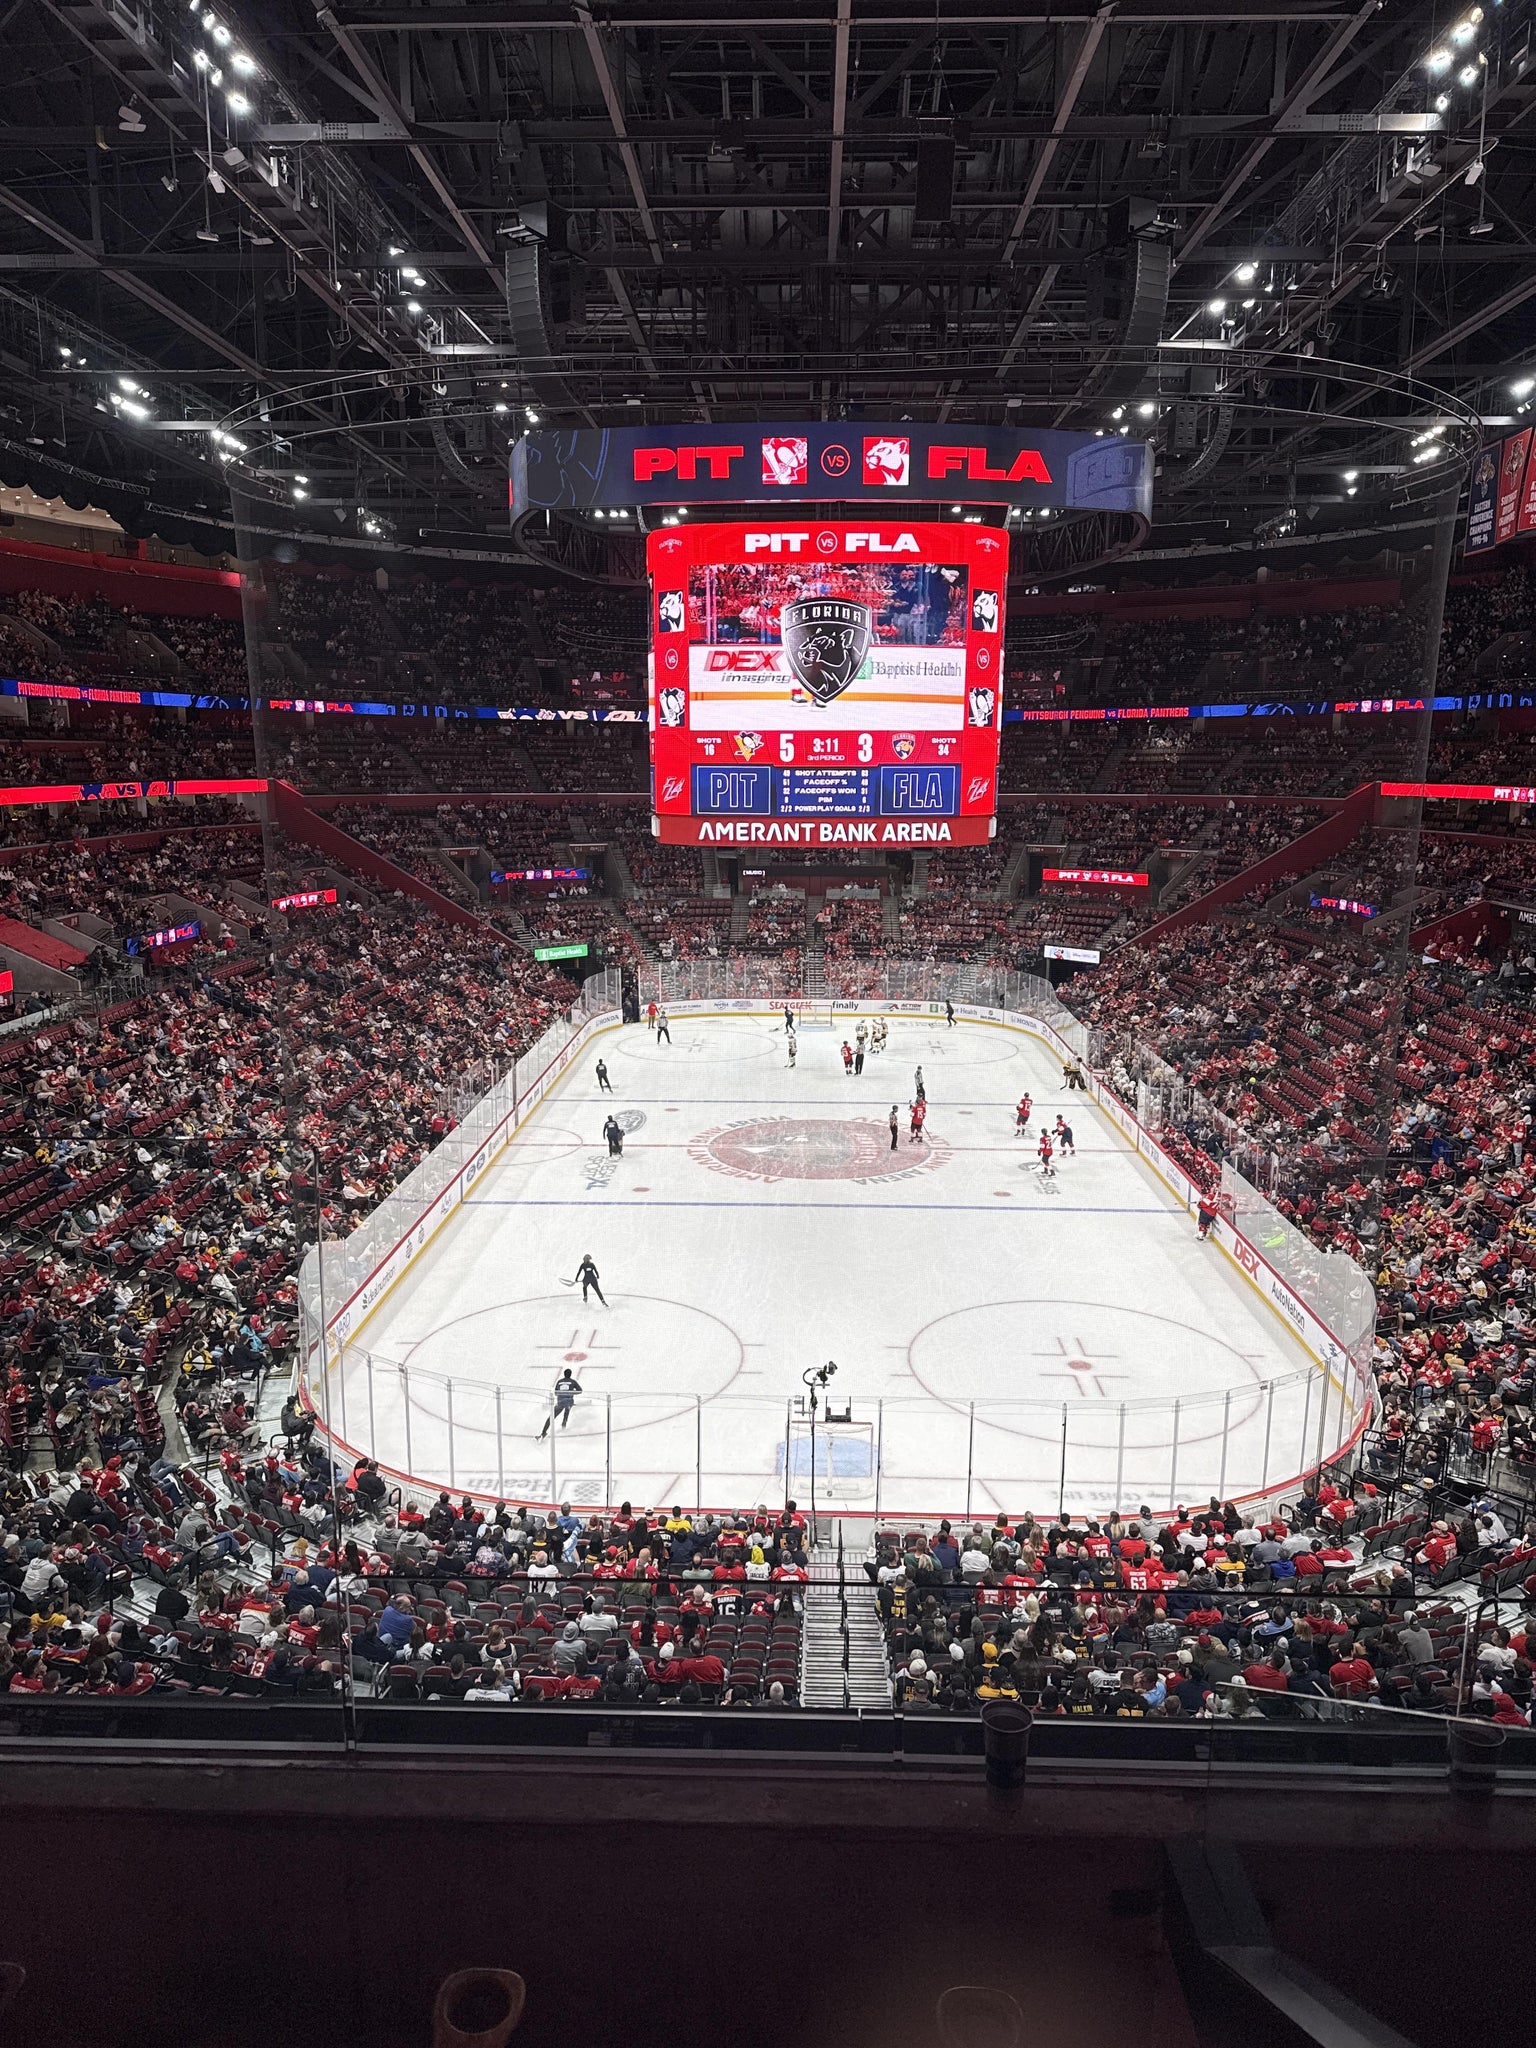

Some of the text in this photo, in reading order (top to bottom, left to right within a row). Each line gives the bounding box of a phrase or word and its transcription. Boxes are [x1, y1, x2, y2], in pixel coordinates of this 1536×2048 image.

[633, 446, 1052, 482] PIT VS FLA
[745, 533, 920, 552] PIT VS FLA
[792, 605, 863, 624] FLORIDA
[703, 650, 786, 671] DEX
[88, 688, 109, 701] FLORIDA
[269, 700, 354, 712] PIT FLA
[1334, 700, 1425, 712] PIT FLA
[557, 710, 589, 721] VS
[1023, 710, 1068, 720] PITTSBURGH
[1070, 709, 1106, 720] PENGUINS
[1117, 708, 1149, 719] FLORIDA
[1150, 706, 1189, 718] PANTHERS
[704, 744, 715, 756] 16
[779, 735, 795, 763] 5
[813, 738, 839, 752] 3:11
[858, 735, 873, 763] 3
[938, 744, 949, 756] 34
[116, 783, 136, 796] VS
[710, 773, 757, 808] PIT
[893, 773, 943, 808] FLA
[1494, 788, 1511, 799] PIT
[698, 822, 952, 842] AMERANT BANK ARENA
[1111, 874, 1134, 882] FLA
[176, 926, 193, 938] FLA
[769, 1001, 812, 1011] SEATGEEK
[832, 1001, 859, 1011] finally
[960, 1007, 978, 1016] Health
[1016, 1017, 1038, 1029] HONDA
[1233, 1238, 1260, 1281] DEX
[1272, 1281, 1305, 1329] AutoNation
[1130, 1577, 1147, 1590] 63
[718, 1603, 736, 1616] 16
[1072, 1705, 1093, 1713] MALKIN
